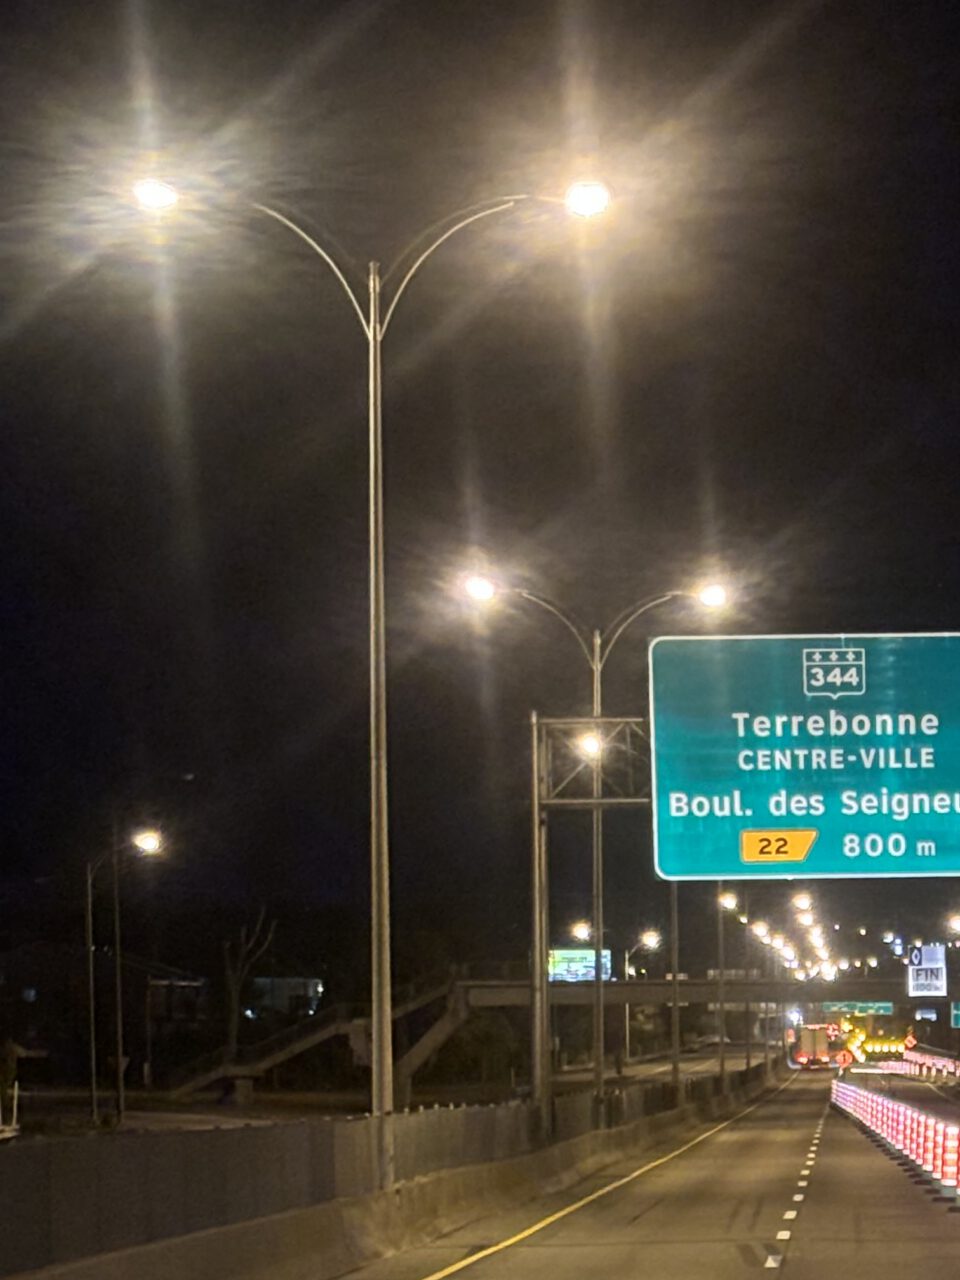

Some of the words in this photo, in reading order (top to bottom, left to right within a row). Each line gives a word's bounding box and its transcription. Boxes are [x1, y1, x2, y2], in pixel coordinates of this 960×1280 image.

[810, 667, 860, 687] 344
[732, 710, 940, 737] Terrebonne
[737, 748, 936, 770] CENTRE-VILLE
[669, 791, 753, 817] Boul.
[769, 790, 825, 816] des
[757, 838, 789, 855] 22
[843, 834, 907, 857] 800
[916, 839, 936, 856] m
